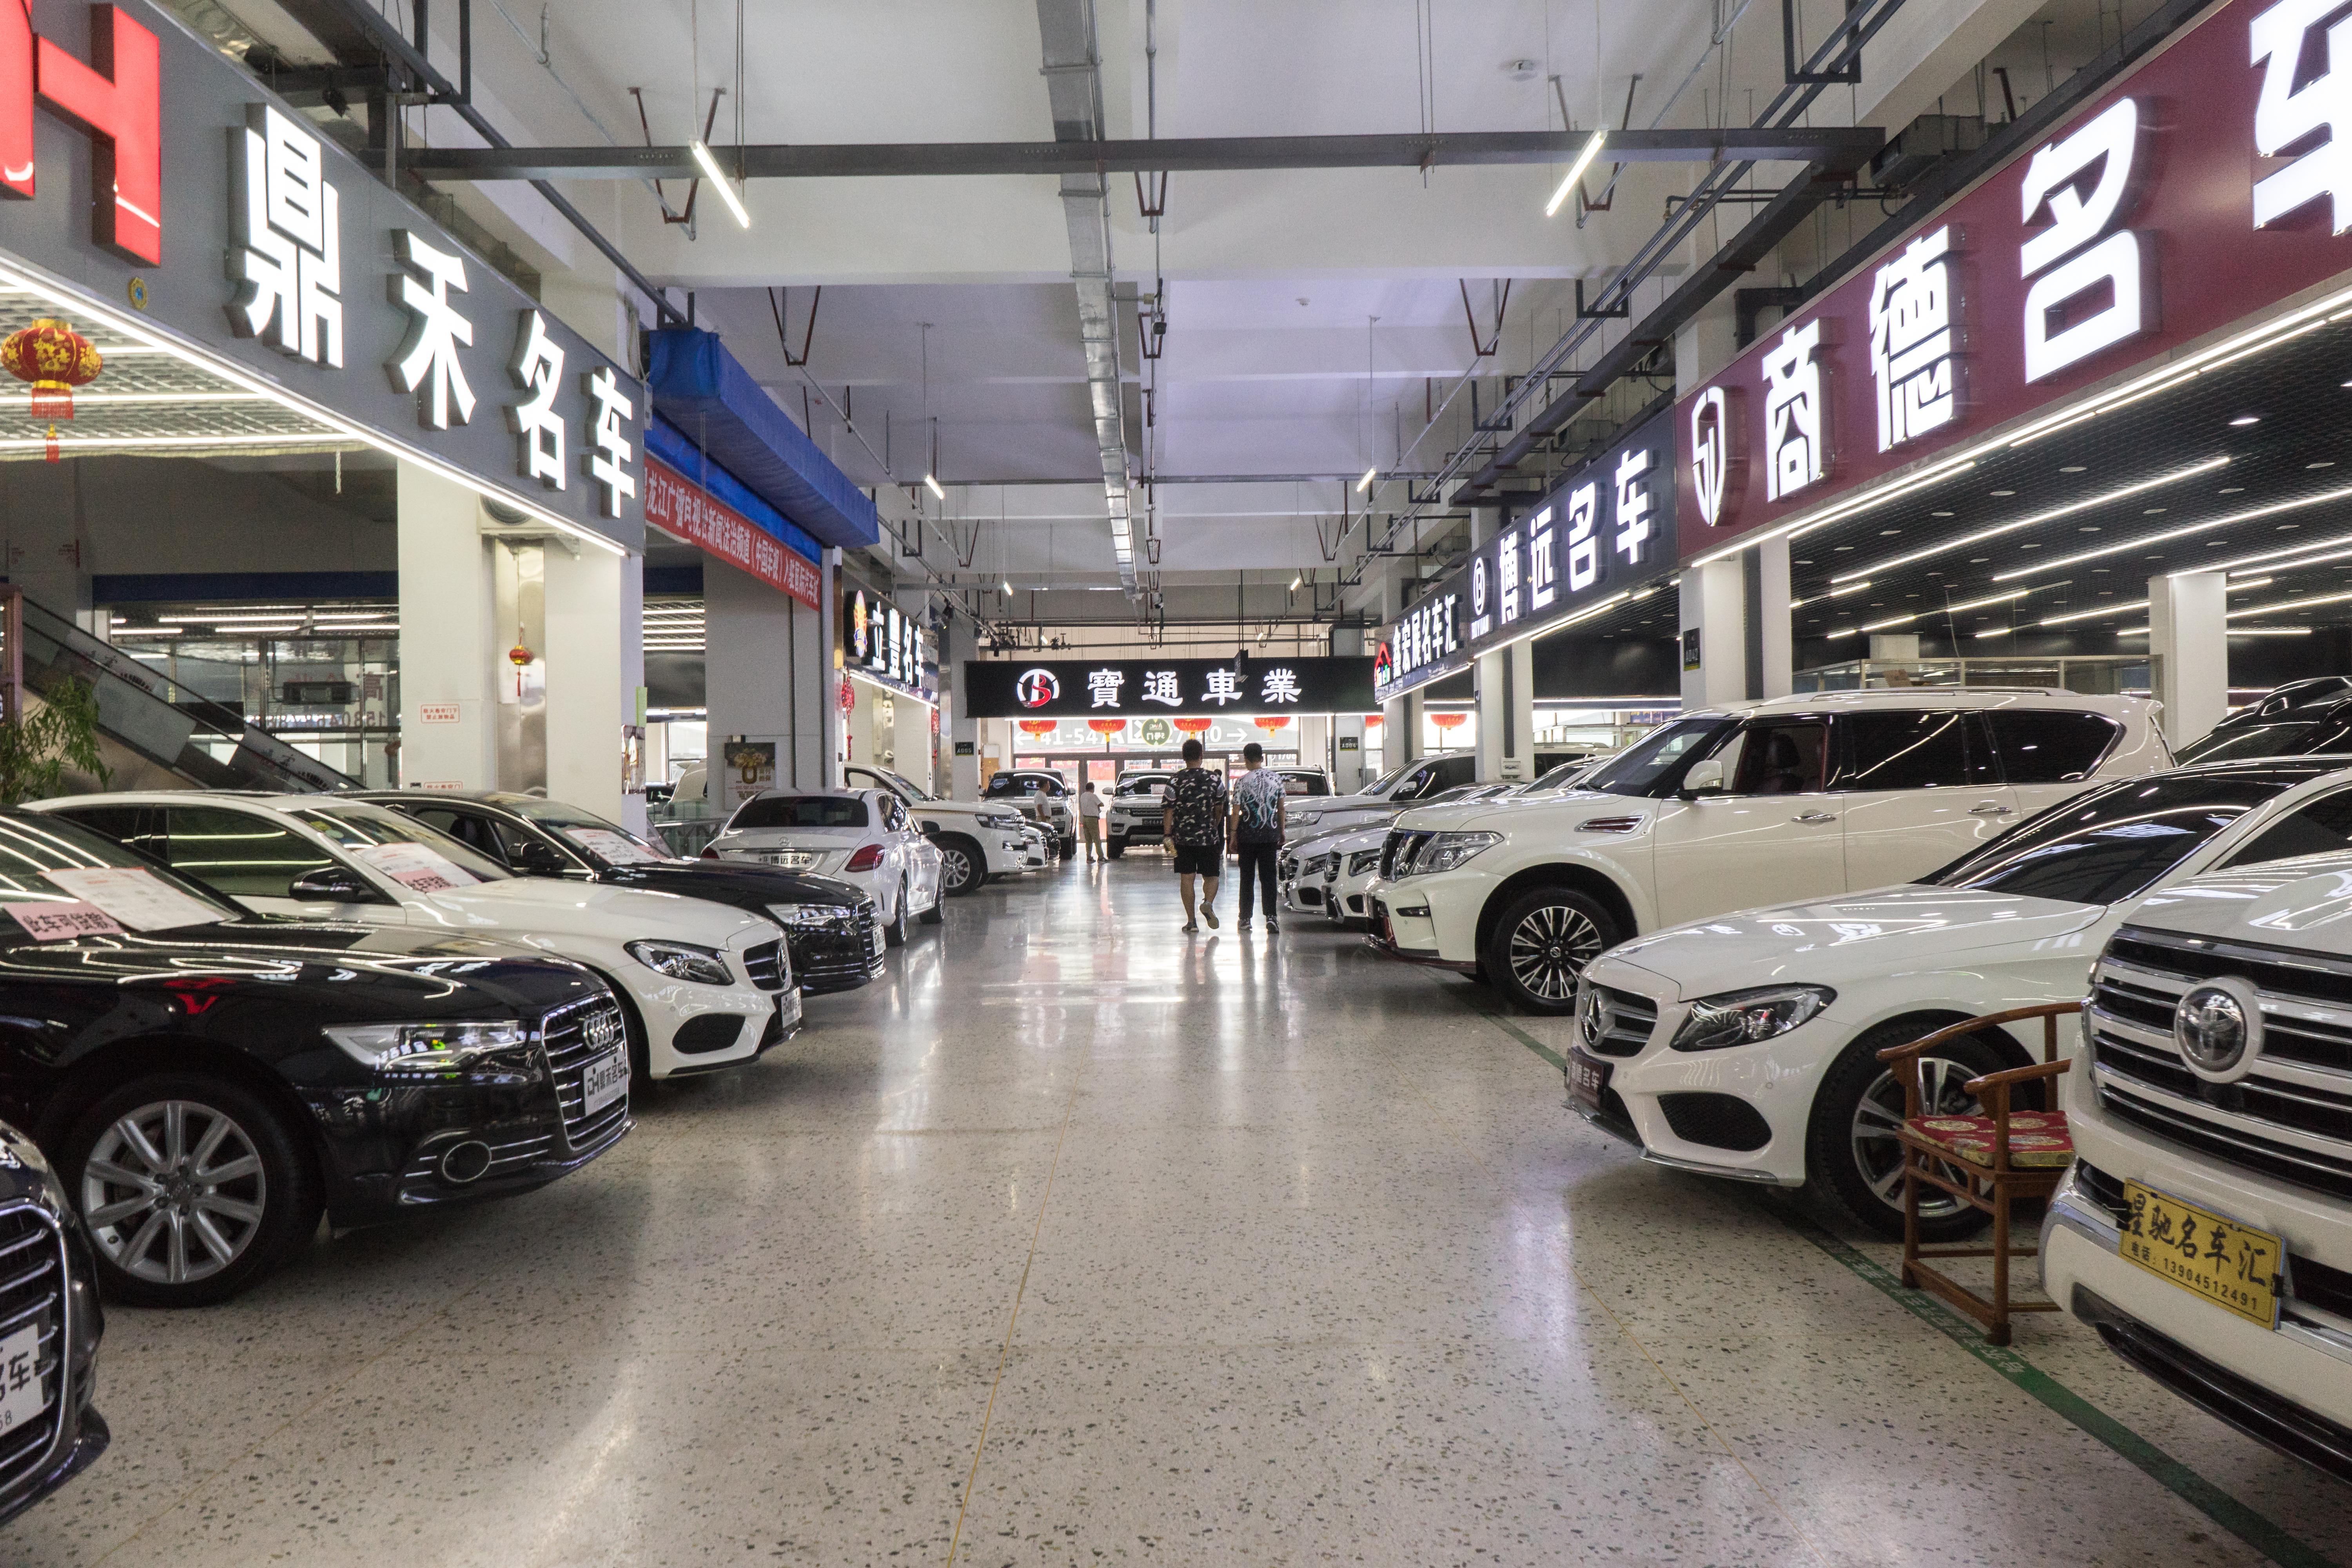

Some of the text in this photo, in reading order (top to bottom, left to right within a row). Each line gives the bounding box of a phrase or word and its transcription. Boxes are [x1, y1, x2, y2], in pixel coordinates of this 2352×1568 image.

[245, 105, 635, 519] 鼎禾名车
[1499, 450, 1648, 624] 博远名车
[1087, 668, 1302, 708] 寶通車業
[2128, 1193, 2267, 1287] 星驰名车汇
